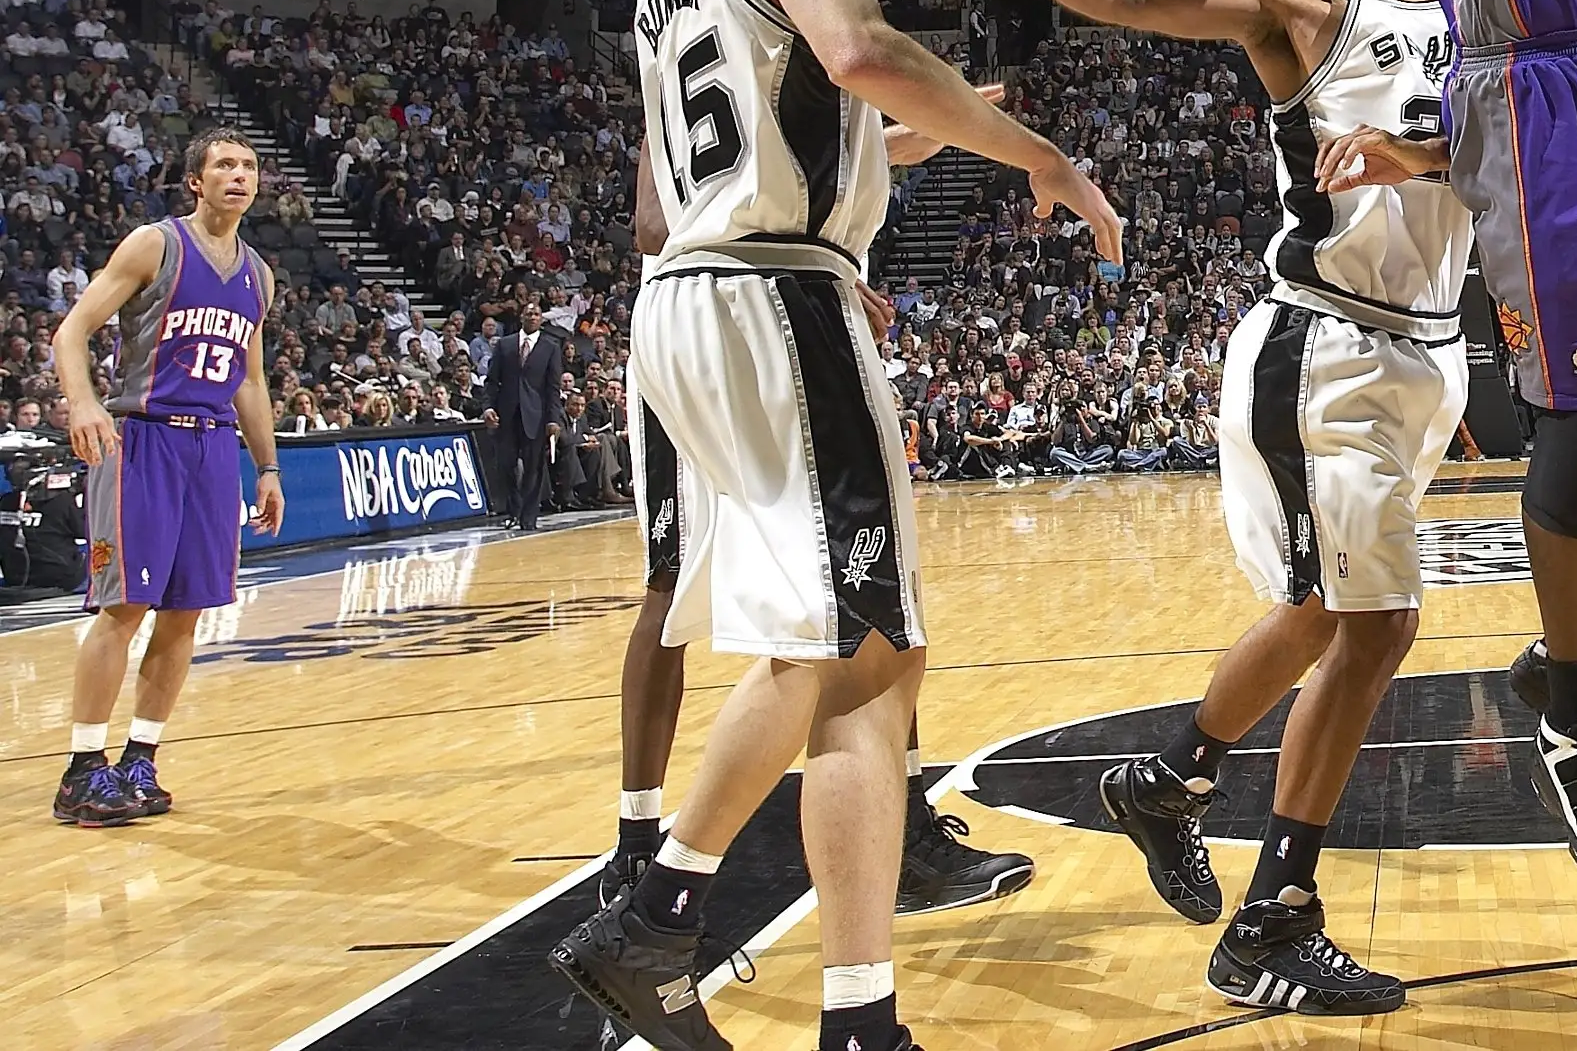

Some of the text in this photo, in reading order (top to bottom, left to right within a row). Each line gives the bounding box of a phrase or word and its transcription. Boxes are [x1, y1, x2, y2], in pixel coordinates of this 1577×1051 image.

[162, 306, 255, 350] PHOENI
[190, 342, 235, 383] 13
[169, 415, 216, 429] SUS
[338, 443, 457, 521] NBA Cares
[655, 973, 698, 1015] N
